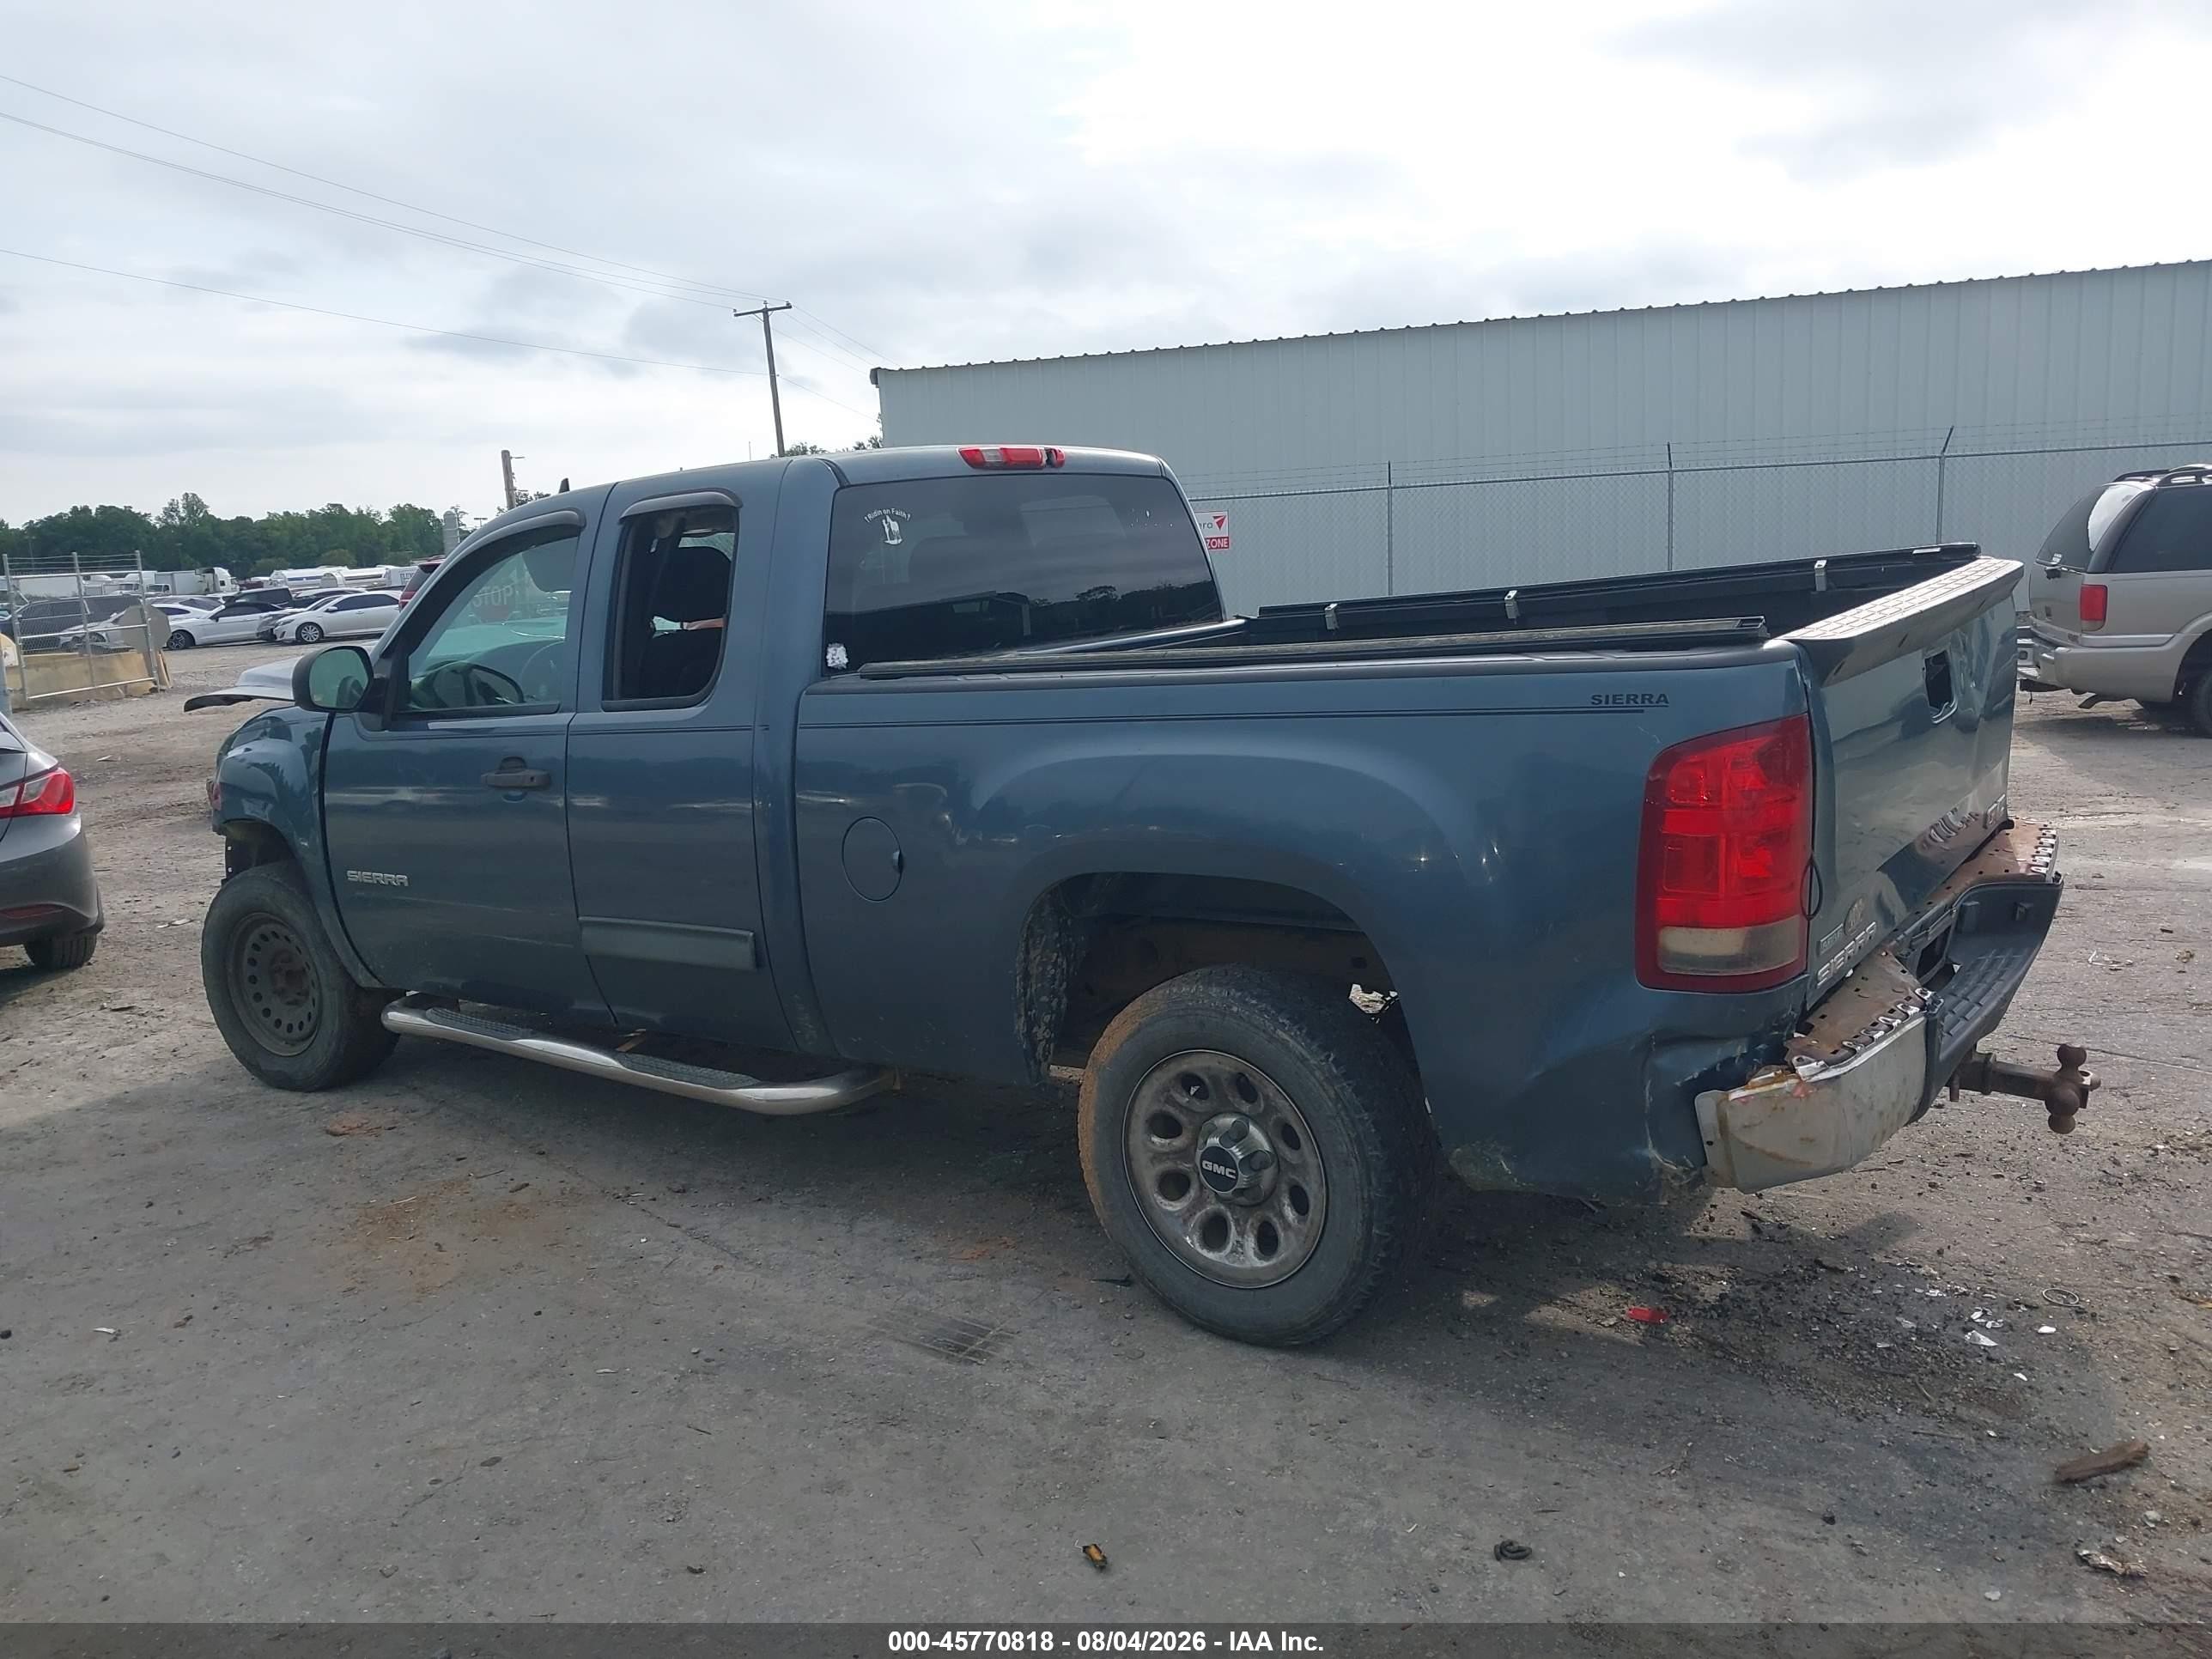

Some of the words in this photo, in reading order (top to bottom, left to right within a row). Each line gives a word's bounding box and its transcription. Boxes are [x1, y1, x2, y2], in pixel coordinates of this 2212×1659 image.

[891, 507, 907, 520] Faith
[1206, 538, 1229, 549] ZONE
[1590, 693, 1670, 705] SIERRA
[346, 870, 409, 887] SIERRA
[1817, 921, 1876, 988] SIERRA
[1201, 1160, 1237, 1180] GMC
